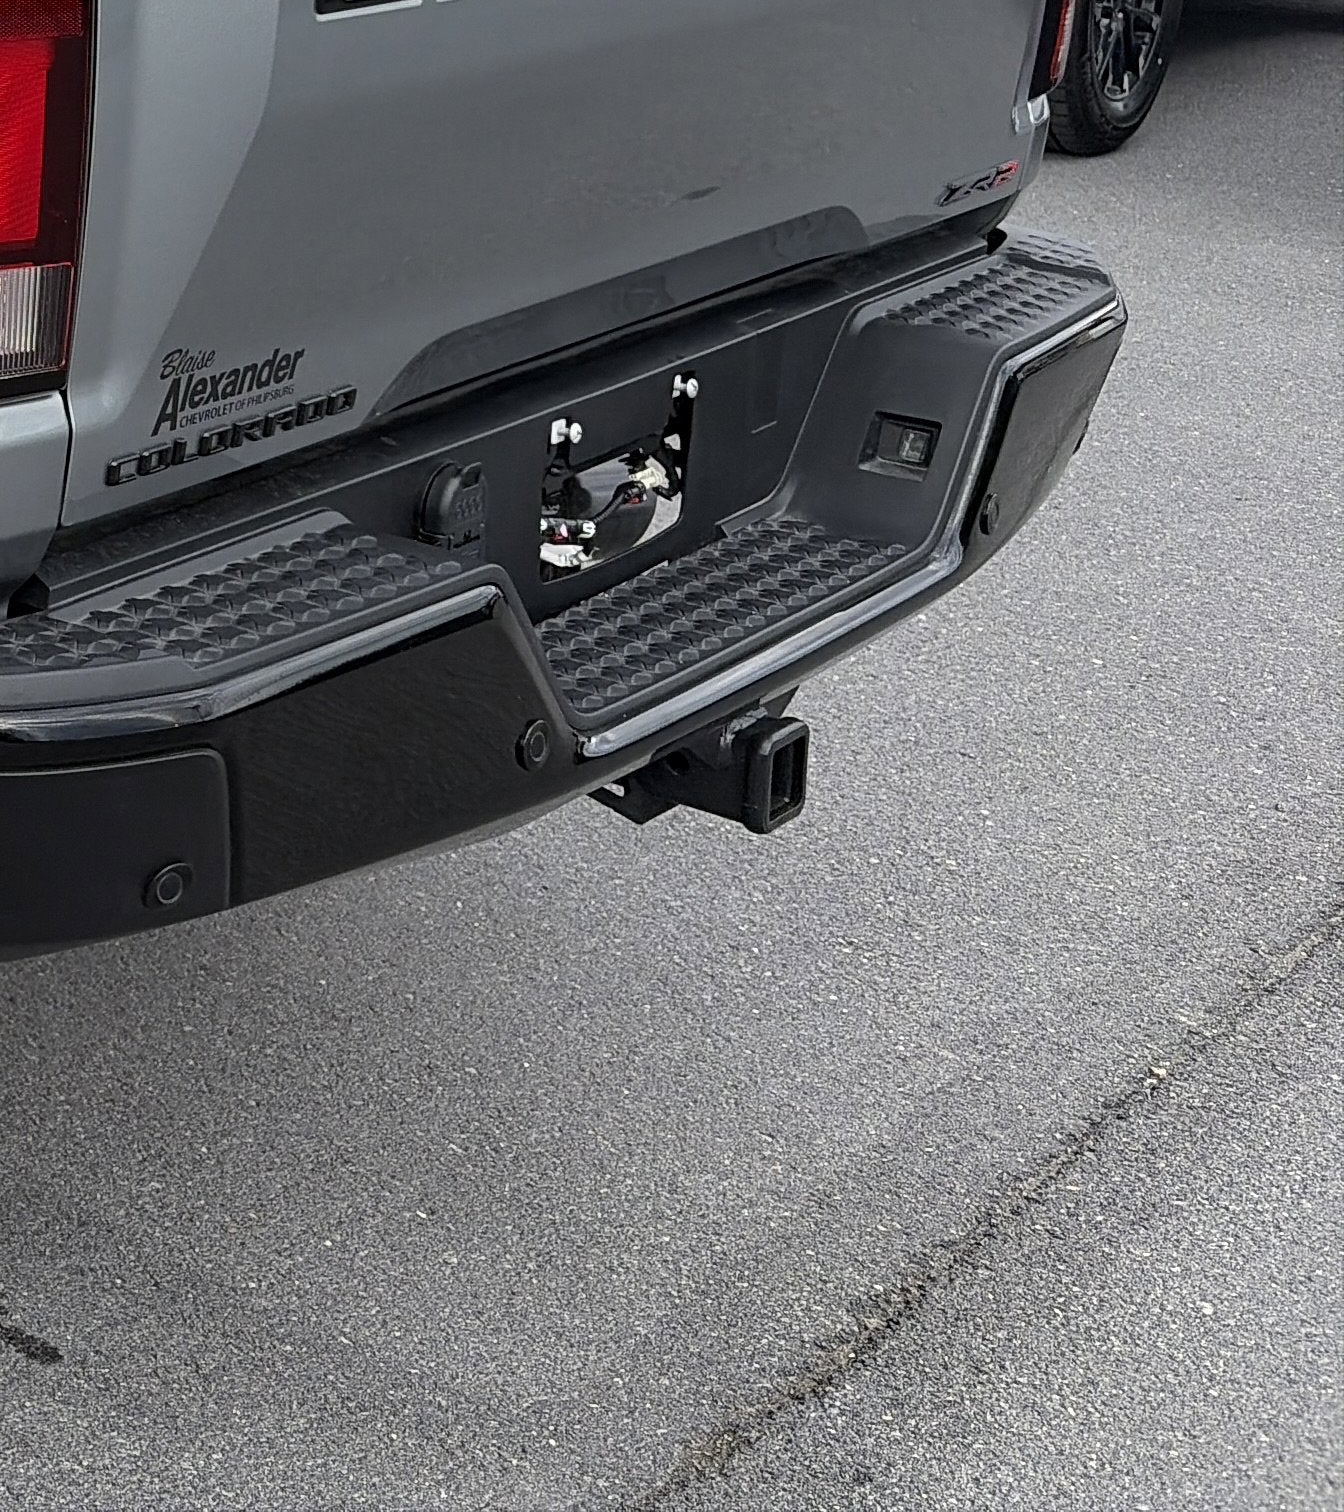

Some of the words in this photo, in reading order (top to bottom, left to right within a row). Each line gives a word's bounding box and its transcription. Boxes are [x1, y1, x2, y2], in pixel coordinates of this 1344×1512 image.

[151, 347, 305, 437] Alexander
[160, 348, 216, 380] Blaise
[105, 384, 358, 487] COLORADO
[179, 400, 235, 428] CHEVROLET
[234, 396, 247, 412] OF
